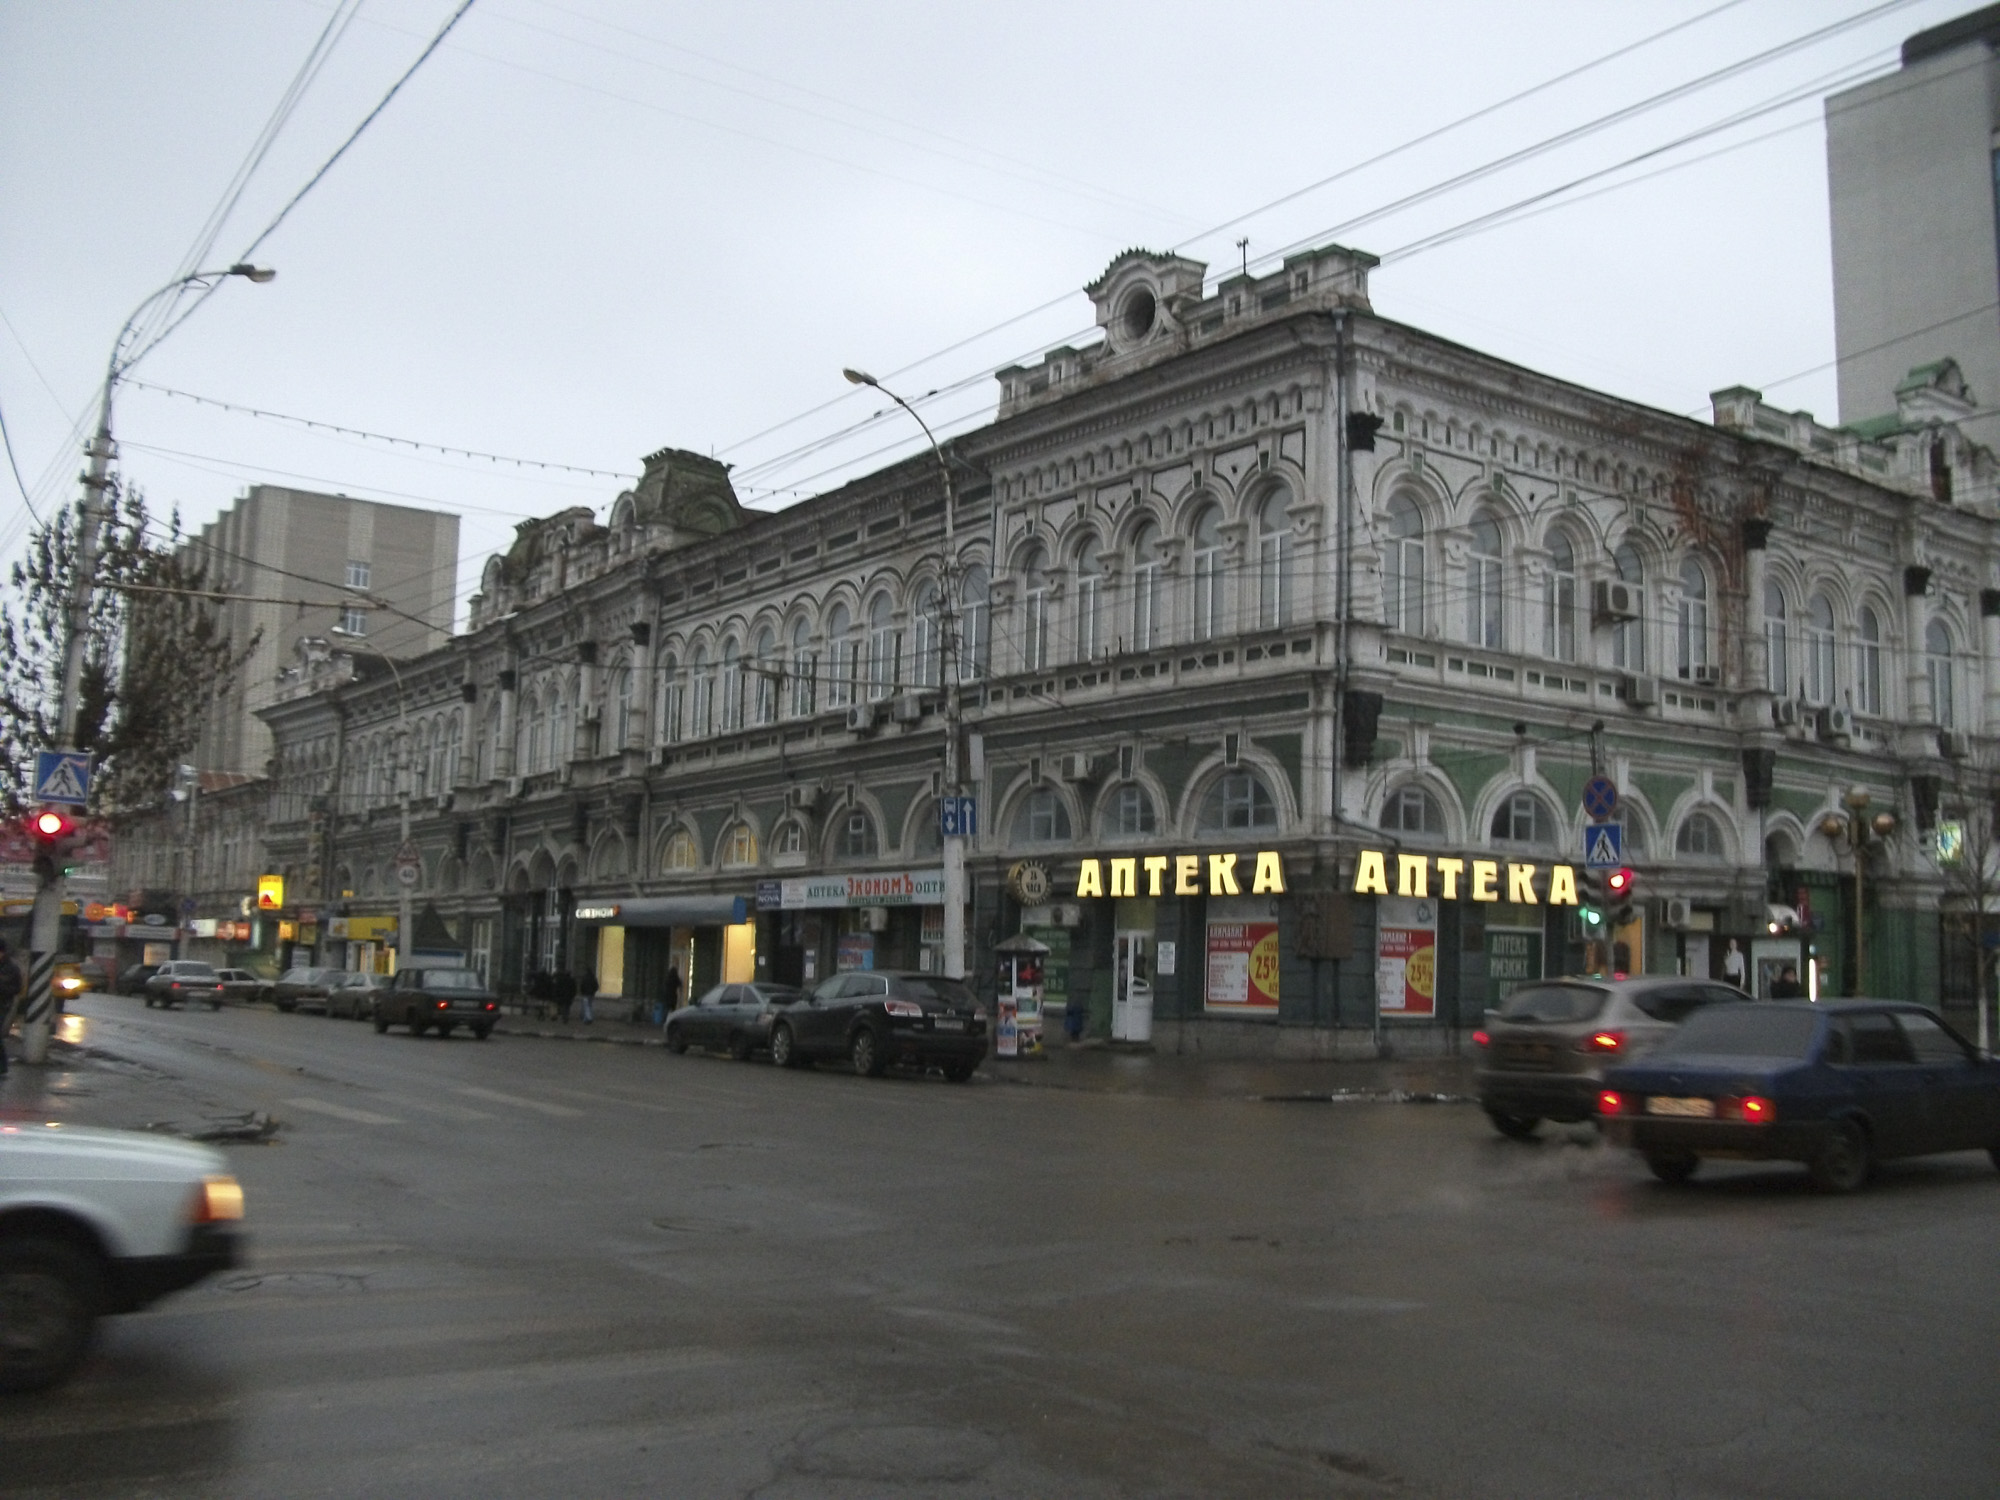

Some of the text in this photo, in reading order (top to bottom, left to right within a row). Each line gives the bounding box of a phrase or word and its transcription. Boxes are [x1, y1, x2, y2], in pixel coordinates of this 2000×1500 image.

[806, 885, 846, 899] АПТЕКА
[847, 873, 914, 897] ЭКОНОМЪ
[1077, 851, 1285, 897] АПТЕКА
[1354, 850, 1579, 905] АПТЕКА
